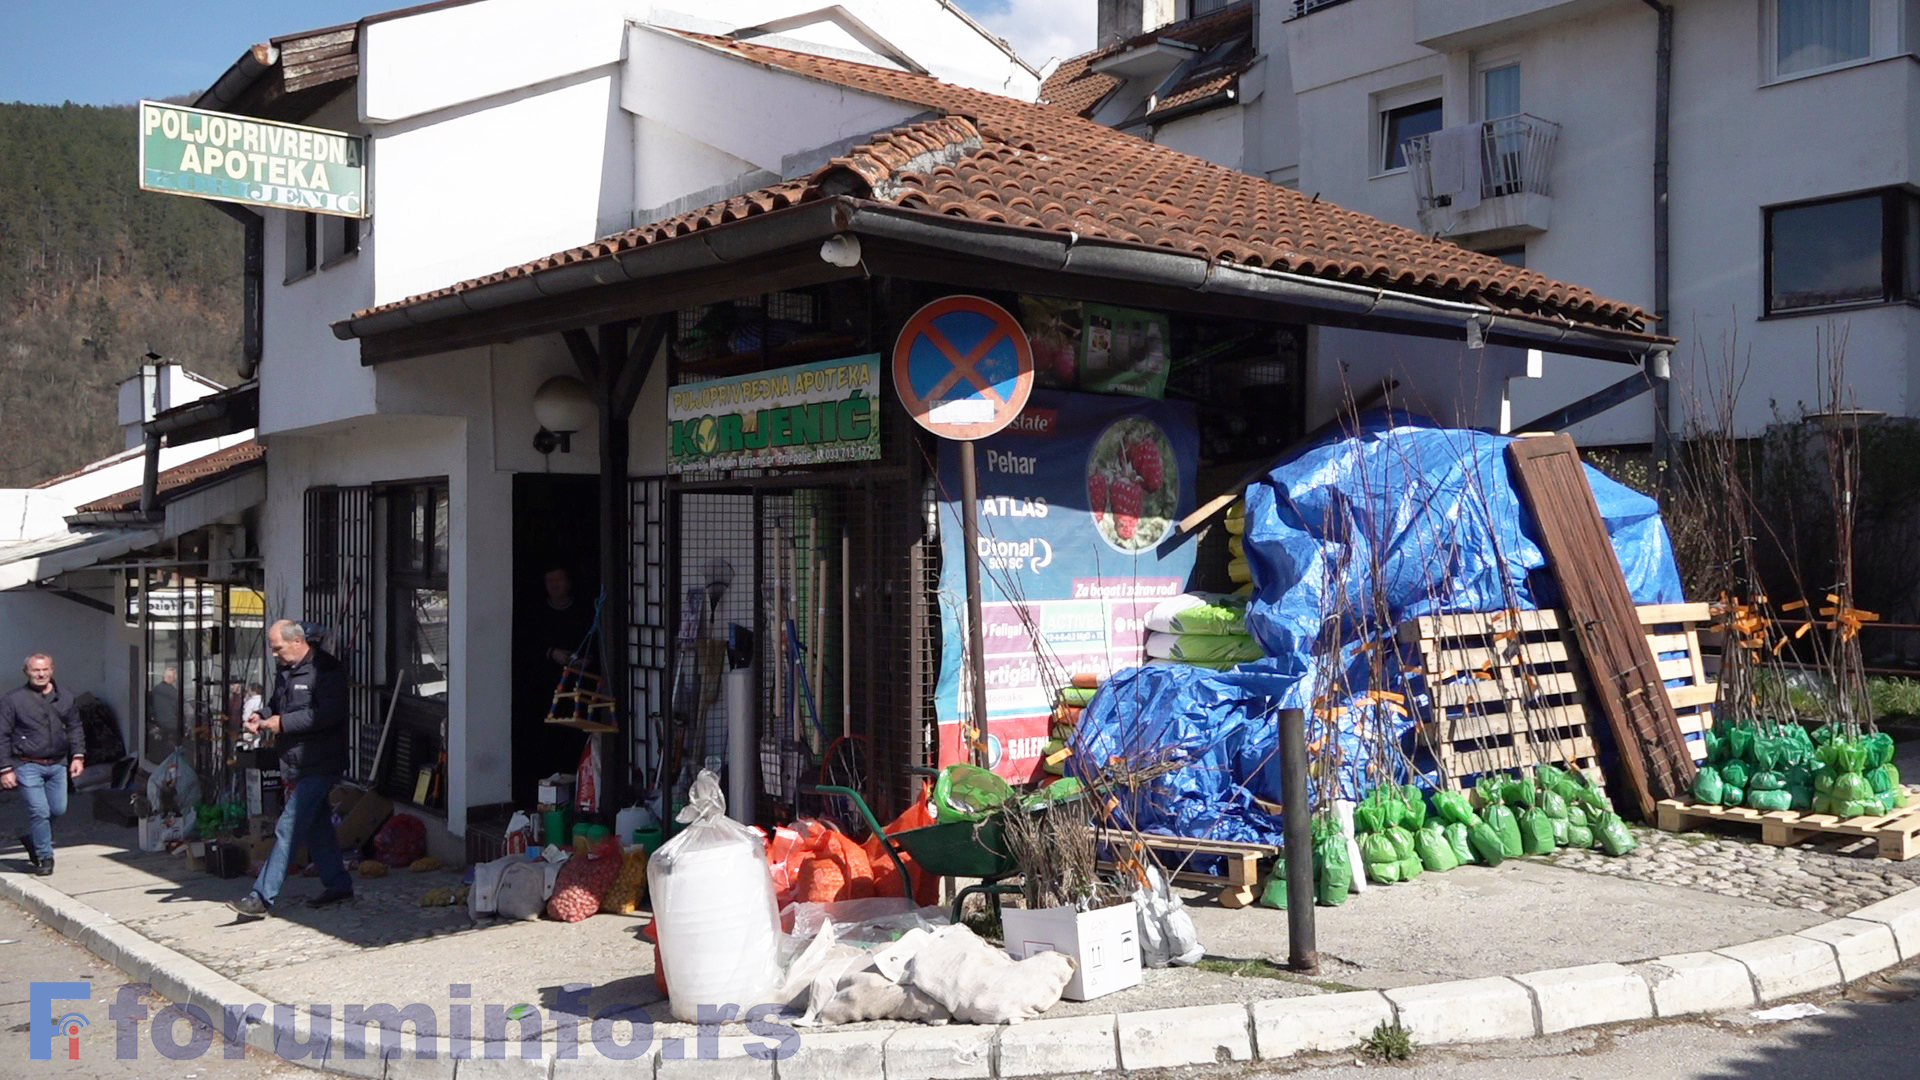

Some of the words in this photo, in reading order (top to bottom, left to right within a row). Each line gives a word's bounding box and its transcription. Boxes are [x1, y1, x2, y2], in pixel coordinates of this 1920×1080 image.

[179, 143, 330, 192] APOTEKA
[672, 375, 790, 413] POLJOPRIVREDNA
[794, 363, 871, 395] APOTEKA
[671, 388, 872, 457] KORJENIĆ
[987, 449, 1037, 475] Pehar
[982, 495, 1048, 518] ATLAS
[977, 536, 1034, 557] Dional
[1009, 557, 1024, 569] SC
[1075, 583, 1089, 598] Za
[1090, 583, 1121, 599] bogat
[1127, 582, 1156, 597] zdrav
[1156, 581, 1178, 596] rod!
